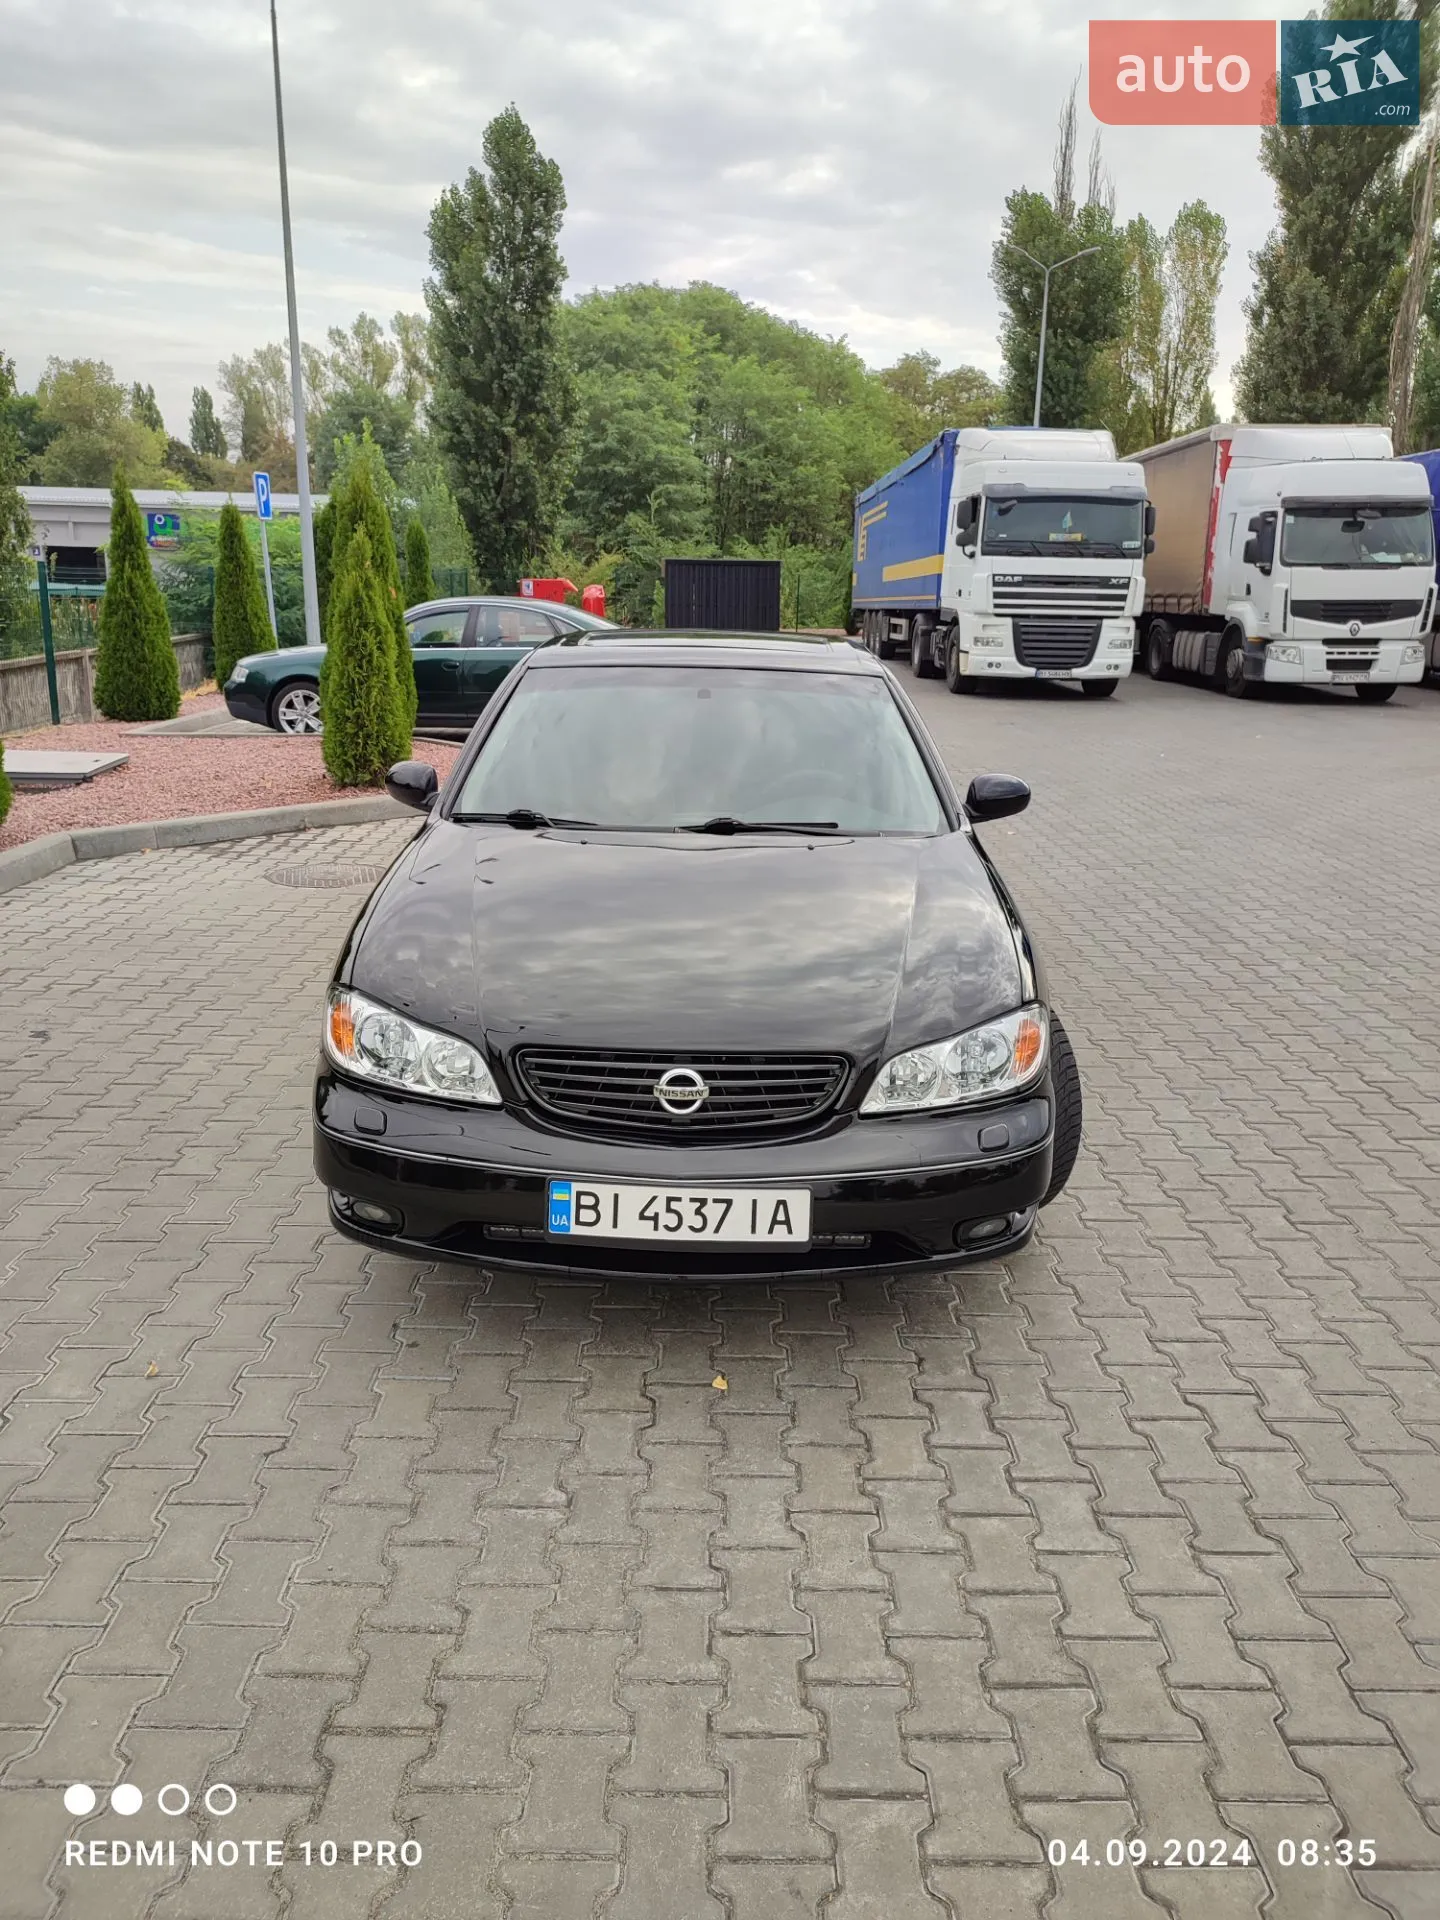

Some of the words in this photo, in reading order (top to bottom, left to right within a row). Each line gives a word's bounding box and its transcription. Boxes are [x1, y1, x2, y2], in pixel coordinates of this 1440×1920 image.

[258, 478, 267, 514] P
[994, 575, 1023, 583] DAF
[659, 1087, 704, 1098] NISSAN
[574, 1190, 619, 1229] BI
[638, 1195, 734, 1234] 4537
[751, 1198, 793, 1235] IA
[552, 1214, 569, 1226] UA
